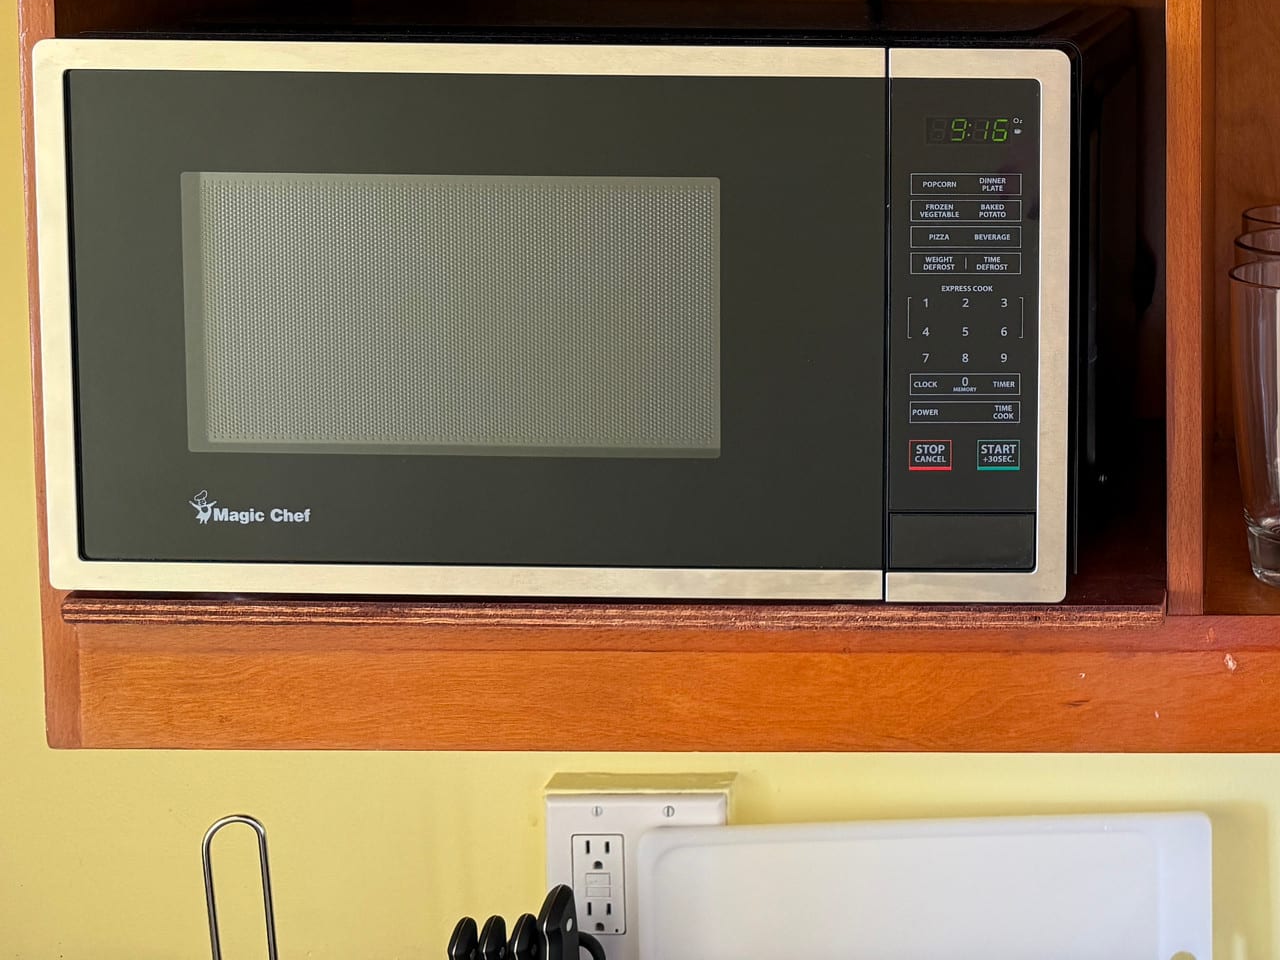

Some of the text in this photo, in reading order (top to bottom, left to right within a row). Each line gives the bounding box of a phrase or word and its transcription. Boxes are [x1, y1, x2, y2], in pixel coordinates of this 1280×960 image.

[952, 119, 1008, 141] 9:16
[923, 299, 1008, 307] 1 2 3
[922, 327, 1008, 336] 4 5 6
[922, 353, 1008, 363] 7 8 9
[962, 377, 969, 386] 0
[916, 445, 945, 454] STOP
[981, 445, 1016, 454] START
[213, 508, 311, 524] Magic Chef
